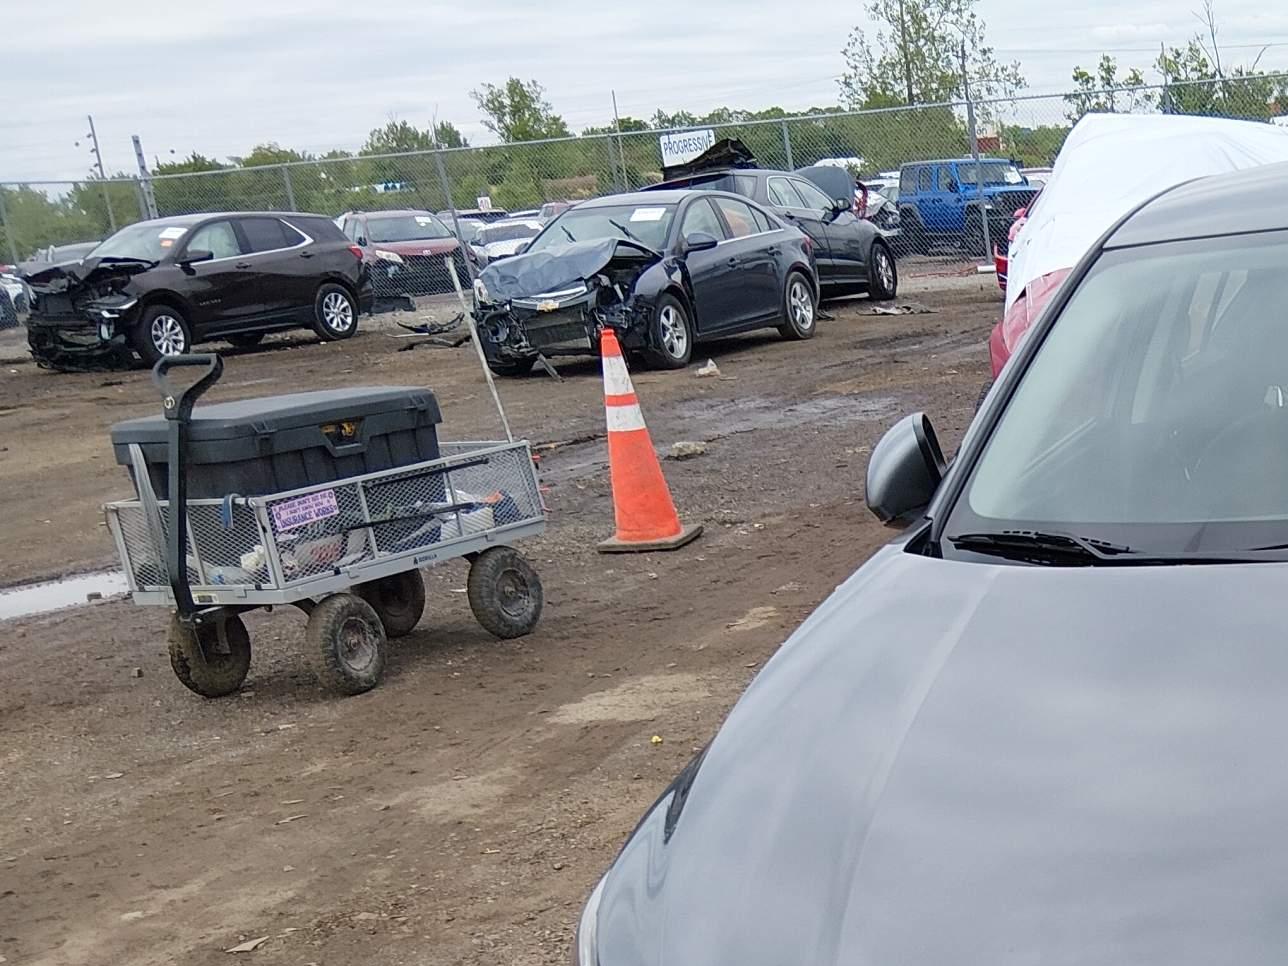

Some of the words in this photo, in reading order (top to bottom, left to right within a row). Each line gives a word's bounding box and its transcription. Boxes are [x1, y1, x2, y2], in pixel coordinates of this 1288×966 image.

[664, 134, 713, 155] PROGRESSIVE
[280, 511, 313, 528] INSURANCE
[313, 505, 335, 518] WORKS
